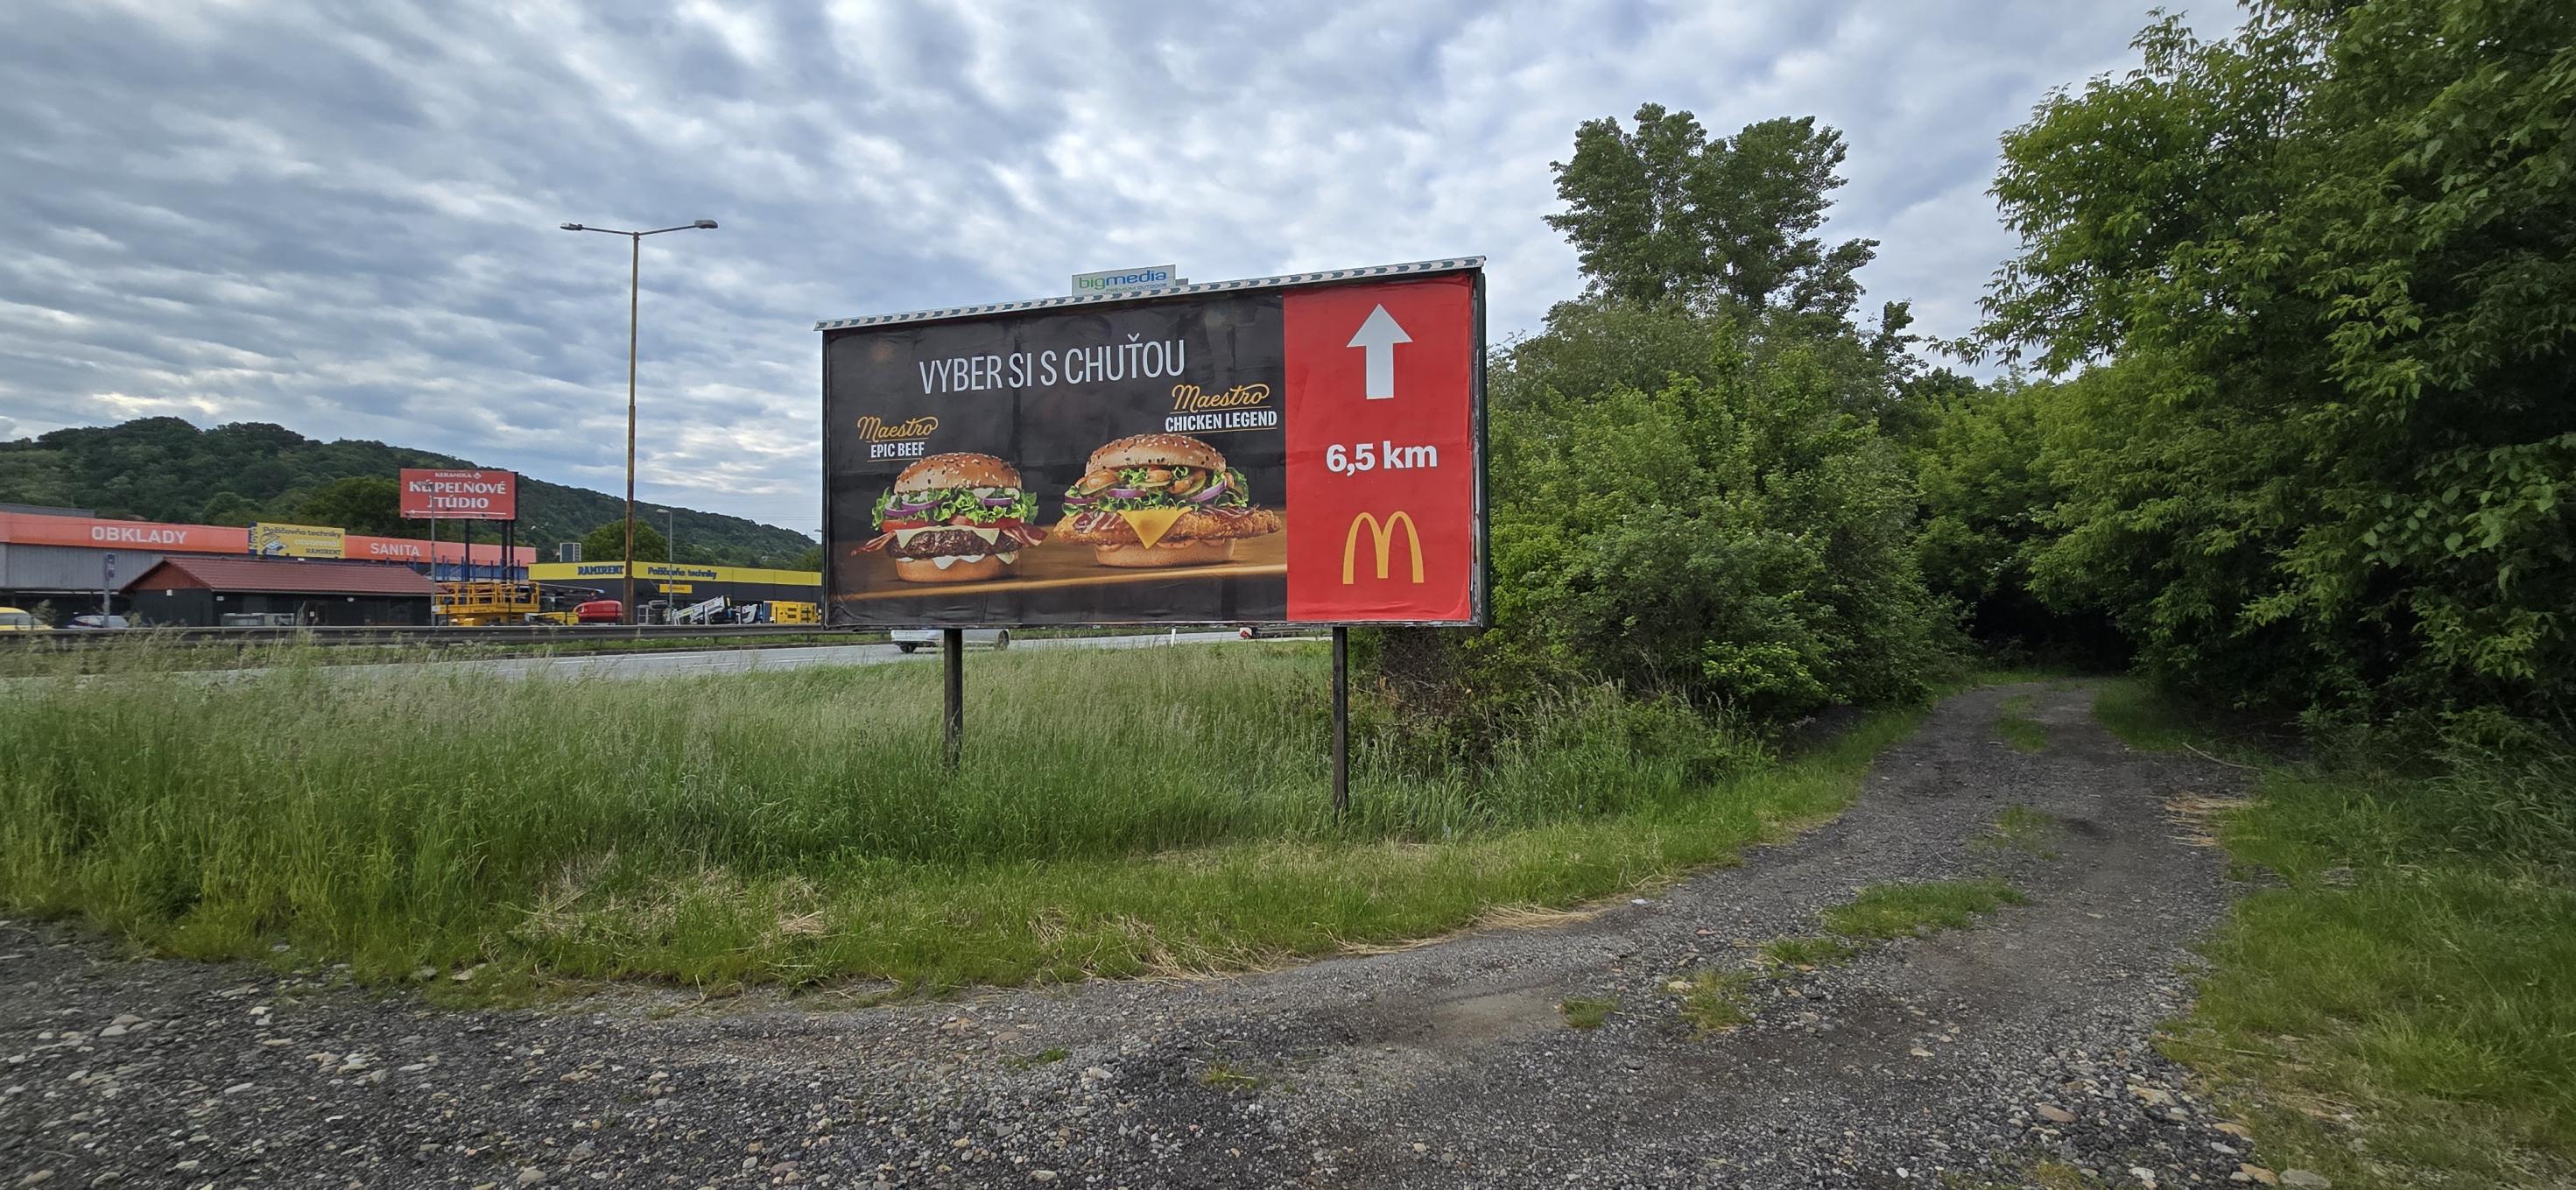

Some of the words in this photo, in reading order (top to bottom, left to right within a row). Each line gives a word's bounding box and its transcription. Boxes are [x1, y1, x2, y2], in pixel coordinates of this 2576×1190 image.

[1078, 270, 1167, 291] bigmedia
[918, 355, 1003, 394] VYBER
[1008, 352, 1032, 388] SI
[1040, 350, 1058, 386] S
[1064, 332, 1185, 384] CHUŤOU
[1171, 383, 1270, 412] Maestro
[856, 416, 939, 443] Maestro
[1165, 412, 1221, 433] CHICKEN
[1225, 411, 1277, 428] LEGEND
[870, 444, 896, 458] EPIC
[897, 441, 926, 457] BEEF
[1326, 443, 1376, 476] 6,5
[1383, 440, 1438, 469] km
[91, 525, 187, 544] OBKLADY
[370, 543, 420, 557] SANITA
[578, 565, 624, 575] RAMIRENT
[687, 569, 718, 580] techniky
